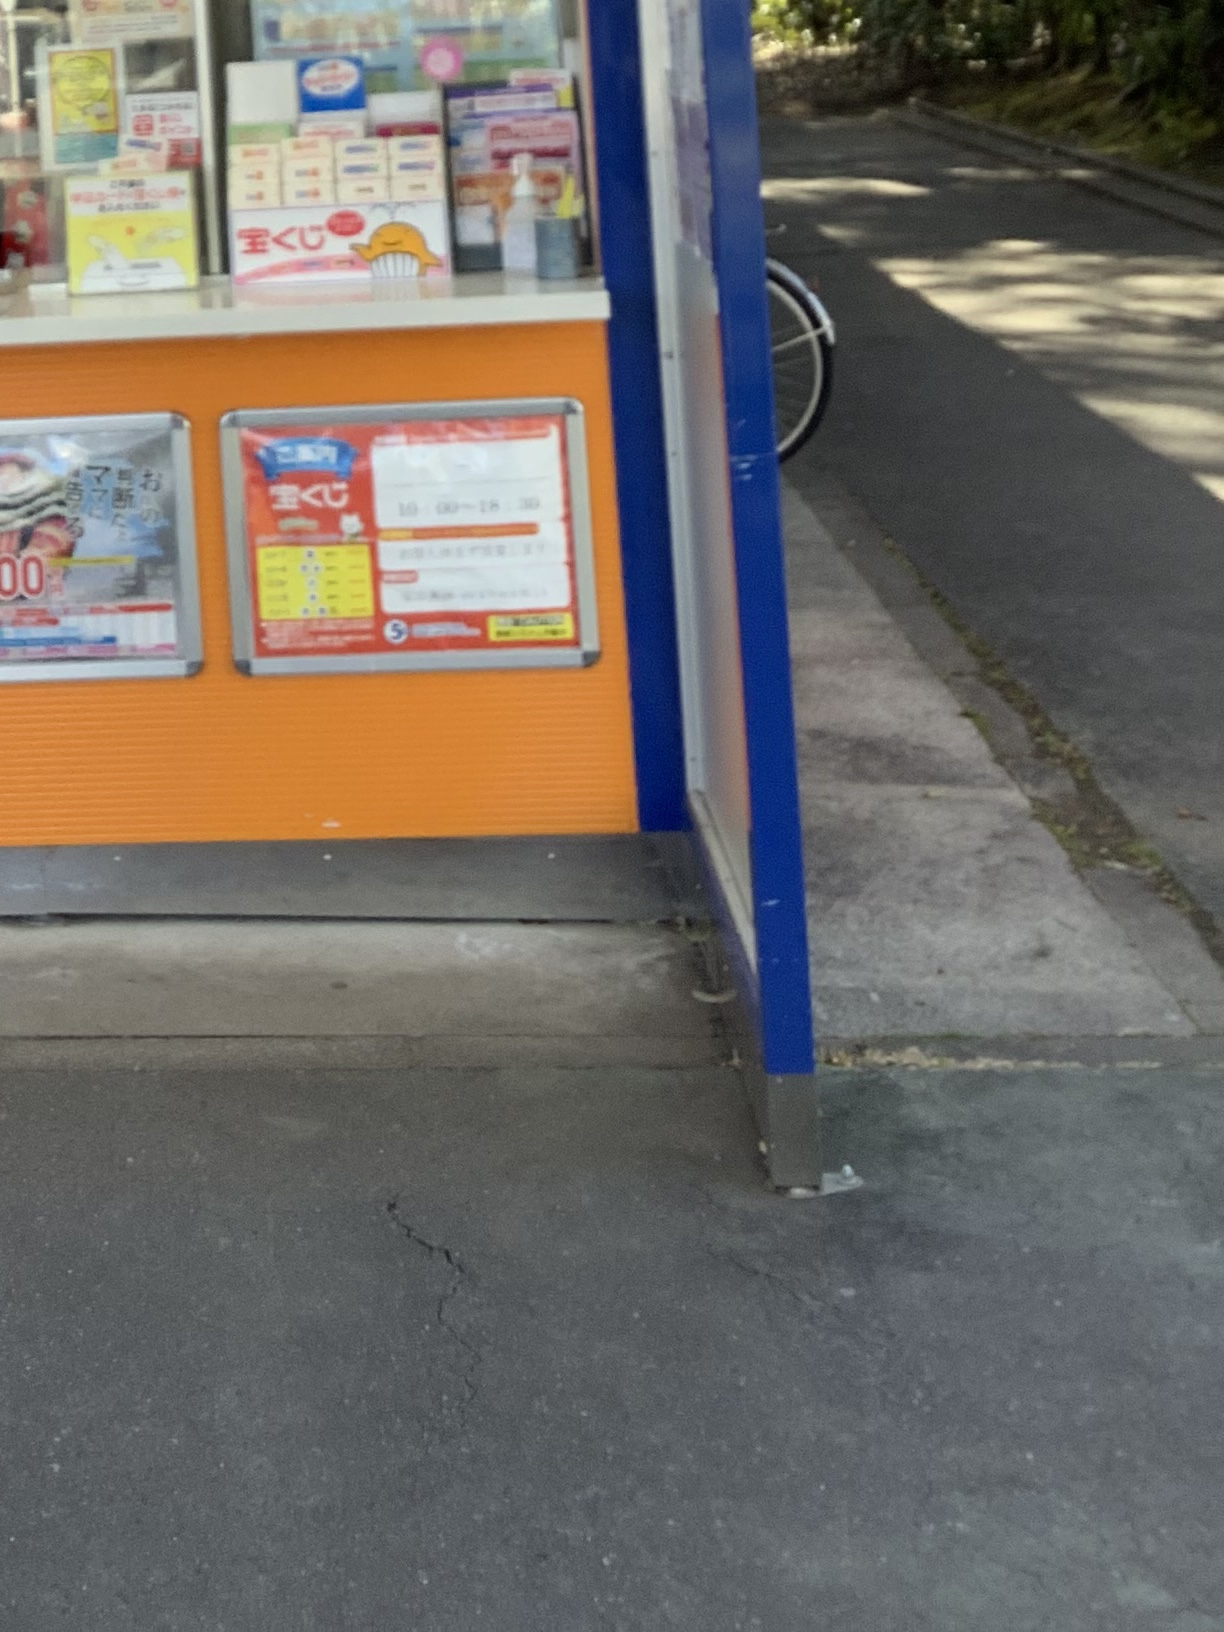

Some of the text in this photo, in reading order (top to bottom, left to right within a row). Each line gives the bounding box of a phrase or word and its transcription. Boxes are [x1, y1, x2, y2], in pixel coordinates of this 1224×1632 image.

[237, 225, 326, 256] 宝くじ
[269, 481, 350, 510] 宝くじ
